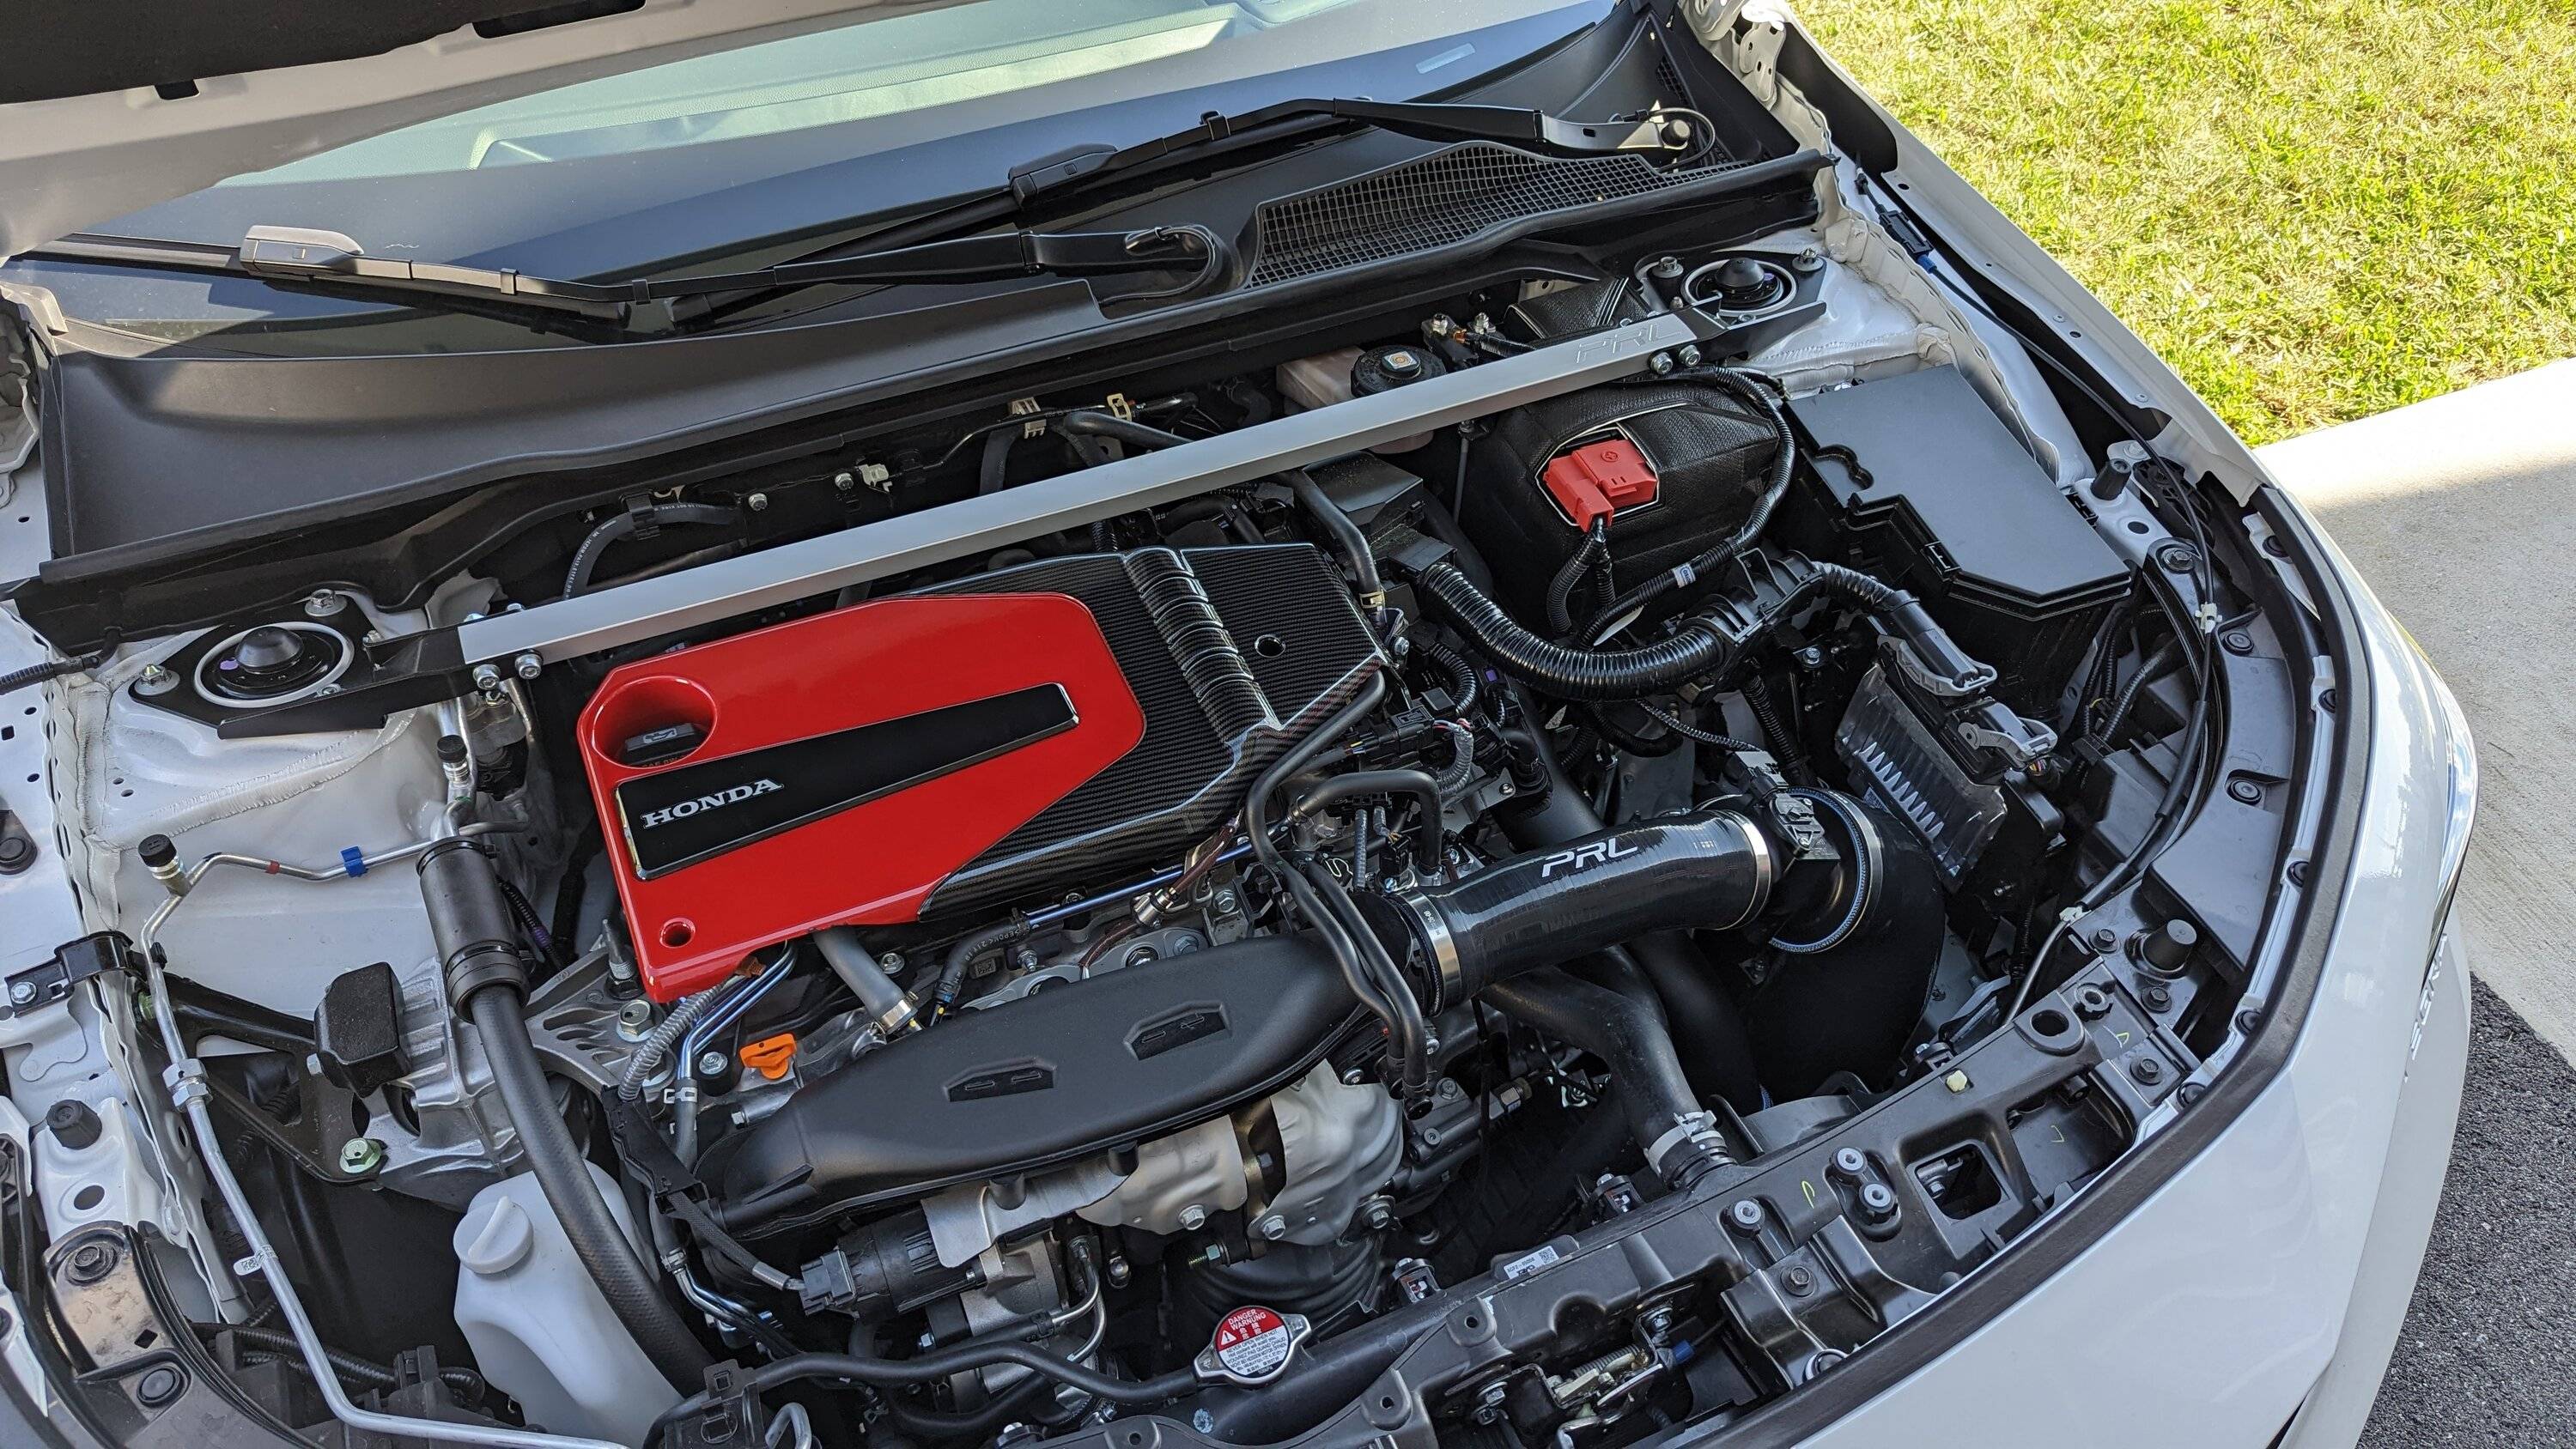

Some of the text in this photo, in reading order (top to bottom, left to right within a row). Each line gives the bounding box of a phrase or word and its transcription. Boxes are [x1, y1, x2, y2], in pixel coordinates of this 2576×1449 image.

[642, 779, 782, 828] HONDA
[1541, 837, 1638, 877] PRL
[1228, 1309, 1257, 1325] DANGER
[1230, 1313, 1267, 1331] WARNUNG
